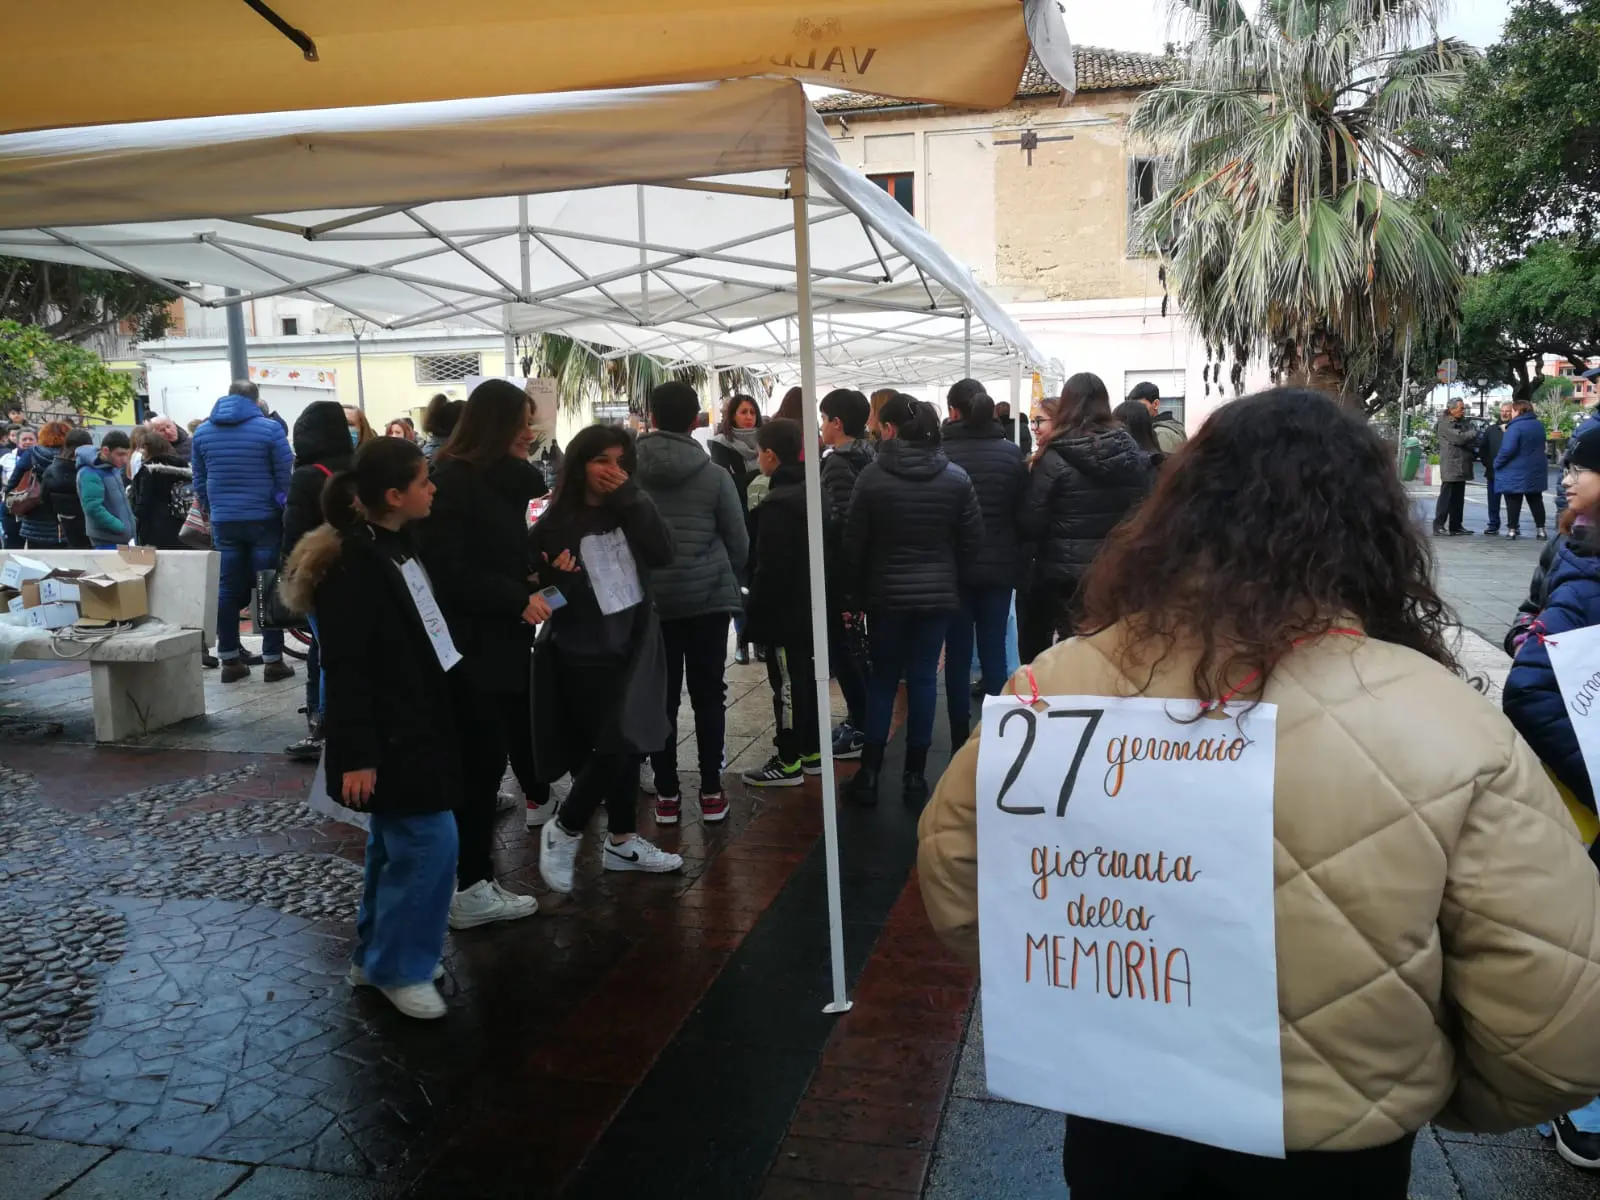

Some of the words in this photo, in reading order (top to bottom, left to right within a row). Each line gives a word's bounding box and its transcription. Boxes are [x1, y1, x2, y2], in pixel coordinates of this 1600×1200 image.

[997, 708, 1104, 817] 27
[1104, 733, 1254, 797] gennaio
[1031, 845, 1202, 900] giornata
[1067, 893, 1156, 931] della
[1026, 932, 1191, 1007] MEMORIA
